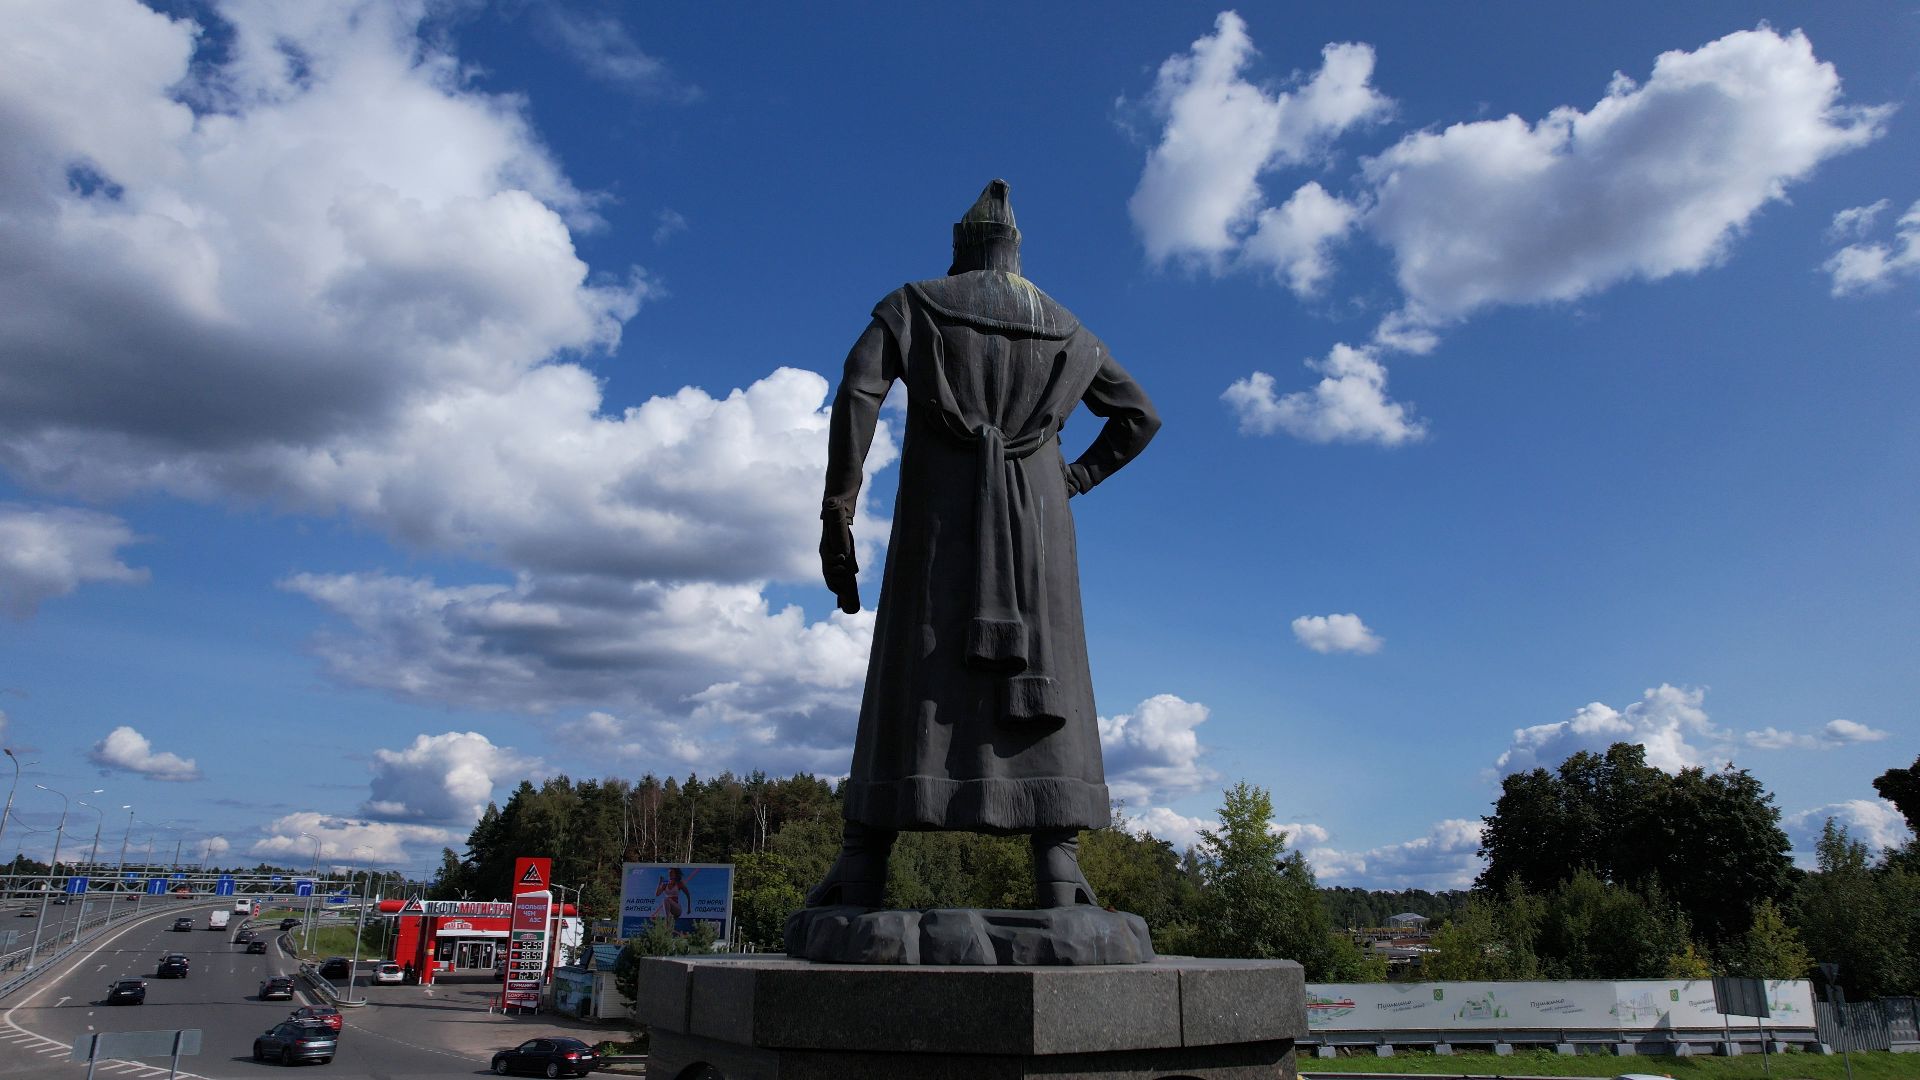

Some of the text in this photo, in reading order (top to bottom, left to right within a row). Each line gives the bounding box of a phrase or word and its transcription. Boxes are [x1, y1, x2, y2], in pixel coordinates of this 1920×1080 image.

[427, 902, 512, 915] НЕФТЬМАГИСТРА
[1377, 1000, 1412, 1011] Пушкино
[1530, 998, 1565, 1008] Пушкино
[1688, 998, 1715, 1008] Пушкин
